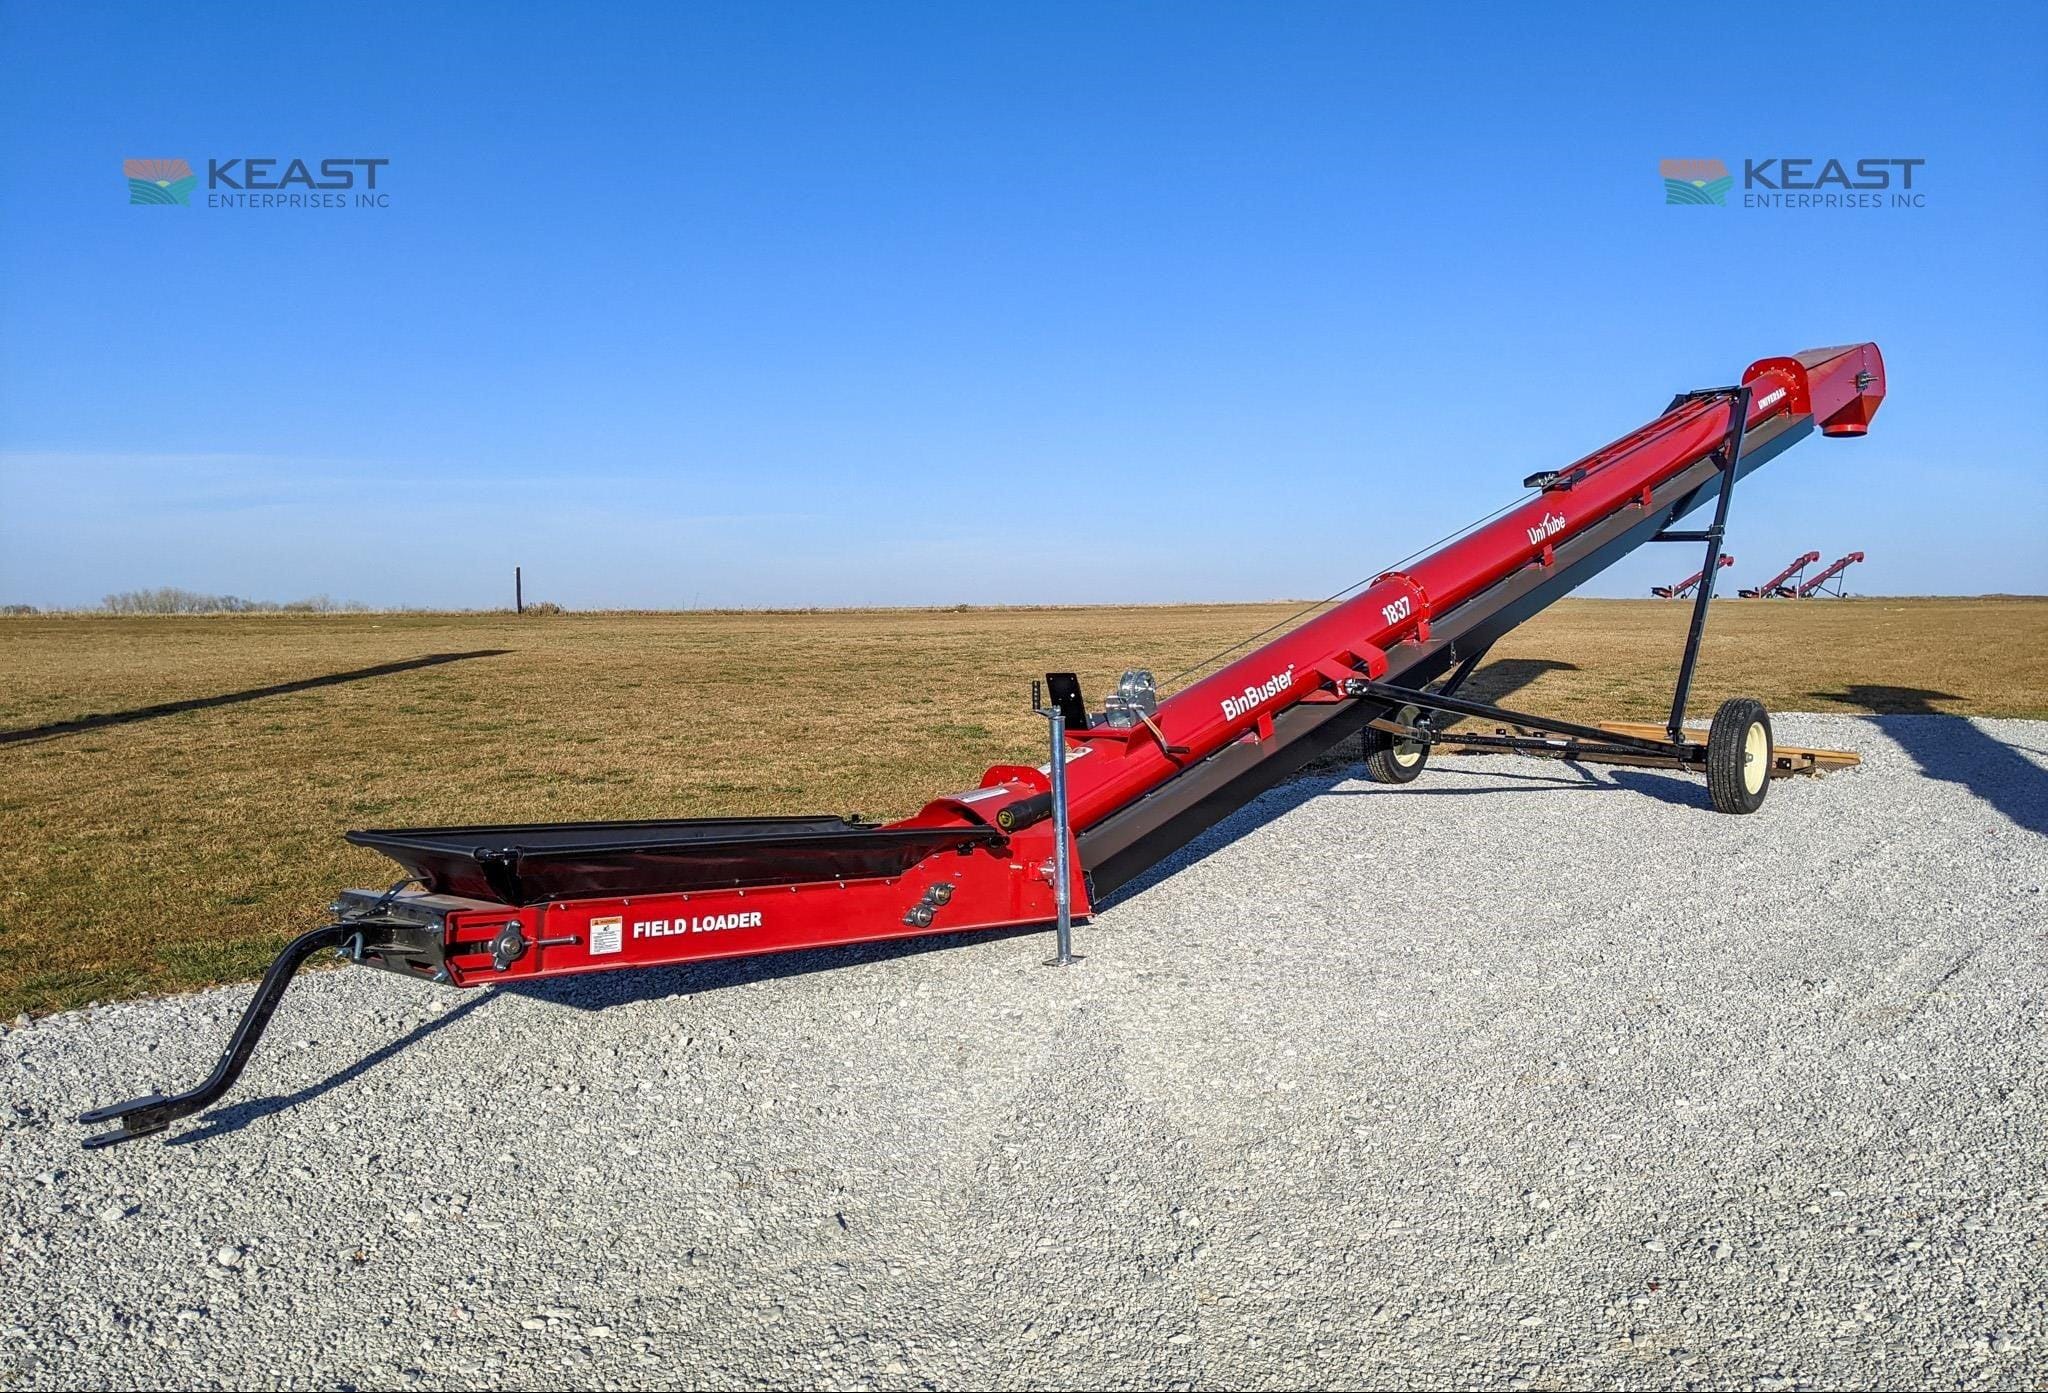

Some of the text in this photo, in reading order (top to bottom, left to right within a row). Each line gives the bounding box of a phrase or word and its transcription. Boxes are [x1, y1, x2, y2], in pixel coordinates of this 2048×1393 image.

[1382, 596, 1411, 625] 1837
[1220, 668, 1294, 722] BinBuster
[633, 911, 762, 938] FIELD LOADER
